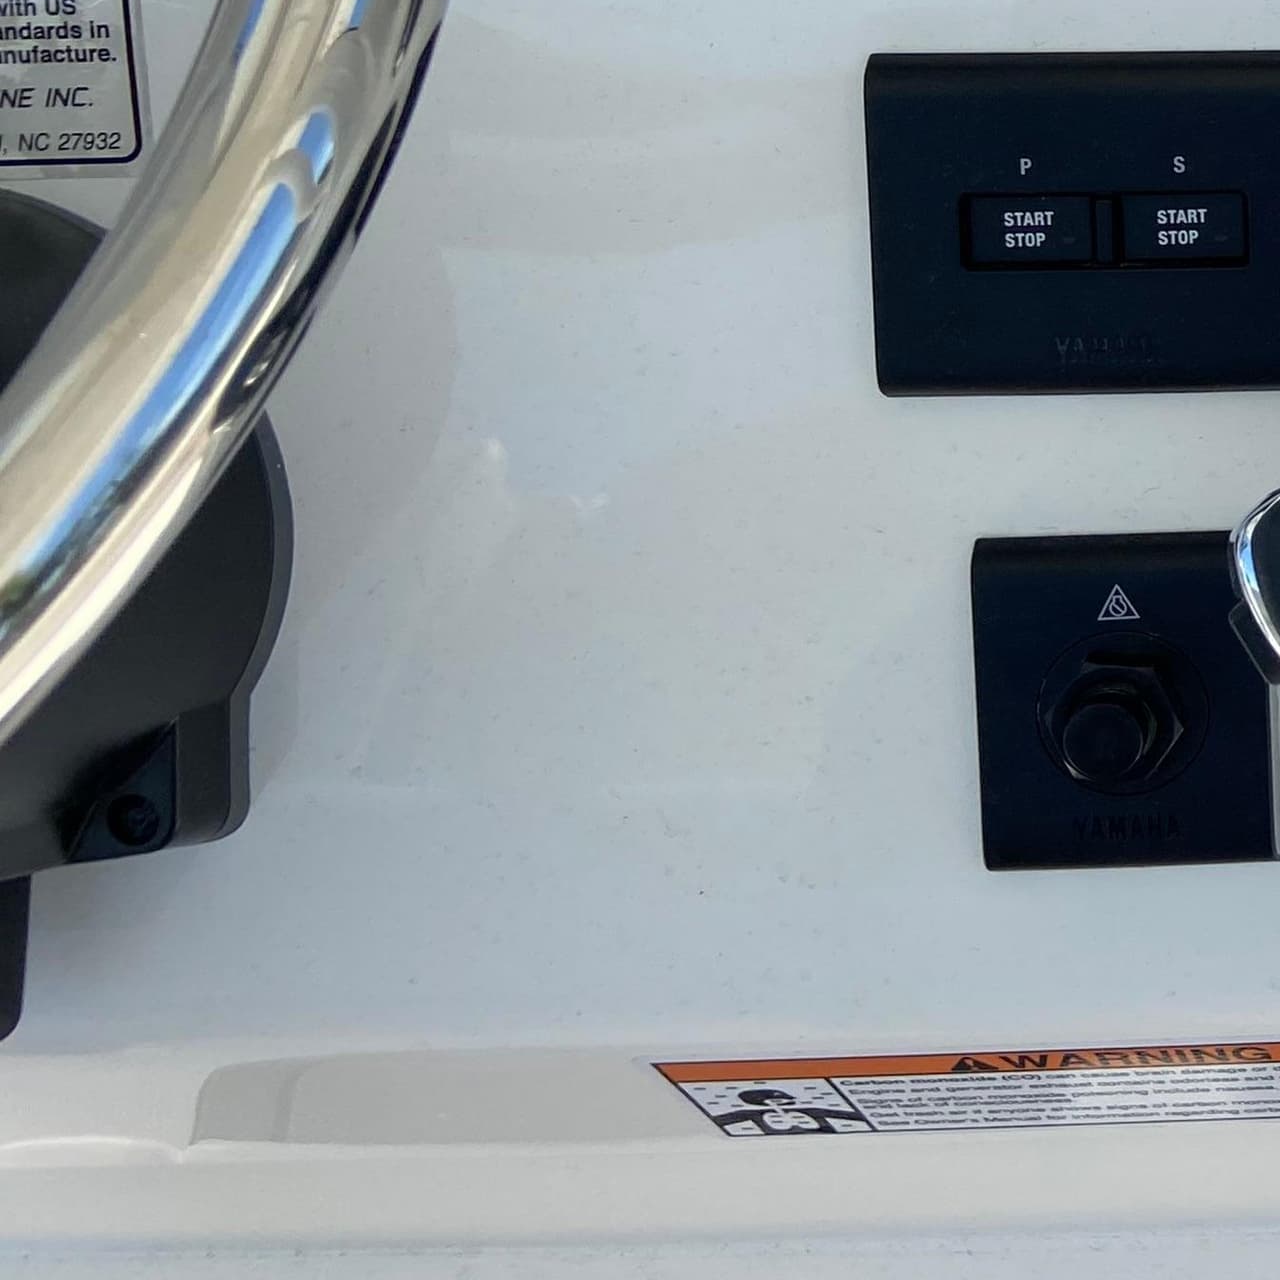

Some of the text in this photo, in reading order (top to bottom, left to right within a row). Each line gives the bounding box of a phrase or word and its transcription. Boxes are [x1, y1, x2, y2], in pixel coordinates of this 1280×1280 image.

[90, 20, 110, 39] in
[0, 45, 117, 64] nufacture.
[45, 87, 94, 107] INC.
[18, 133, 50, 151] NC
[58, 132, 122, 151] 27932
[1020, 158, 1032, 175] P
[1173, 156, 1185, 173] S
[1004, 211, 1054, 227] START
[1157, 208, 1207, 224] START
[1005, 232, 1046, 248] STOP
[1158, 230, 1199, 245] STOP
[998, 1046, 1272, 1069] WARNING
[910, 1075, 996, 1083] monoxide
